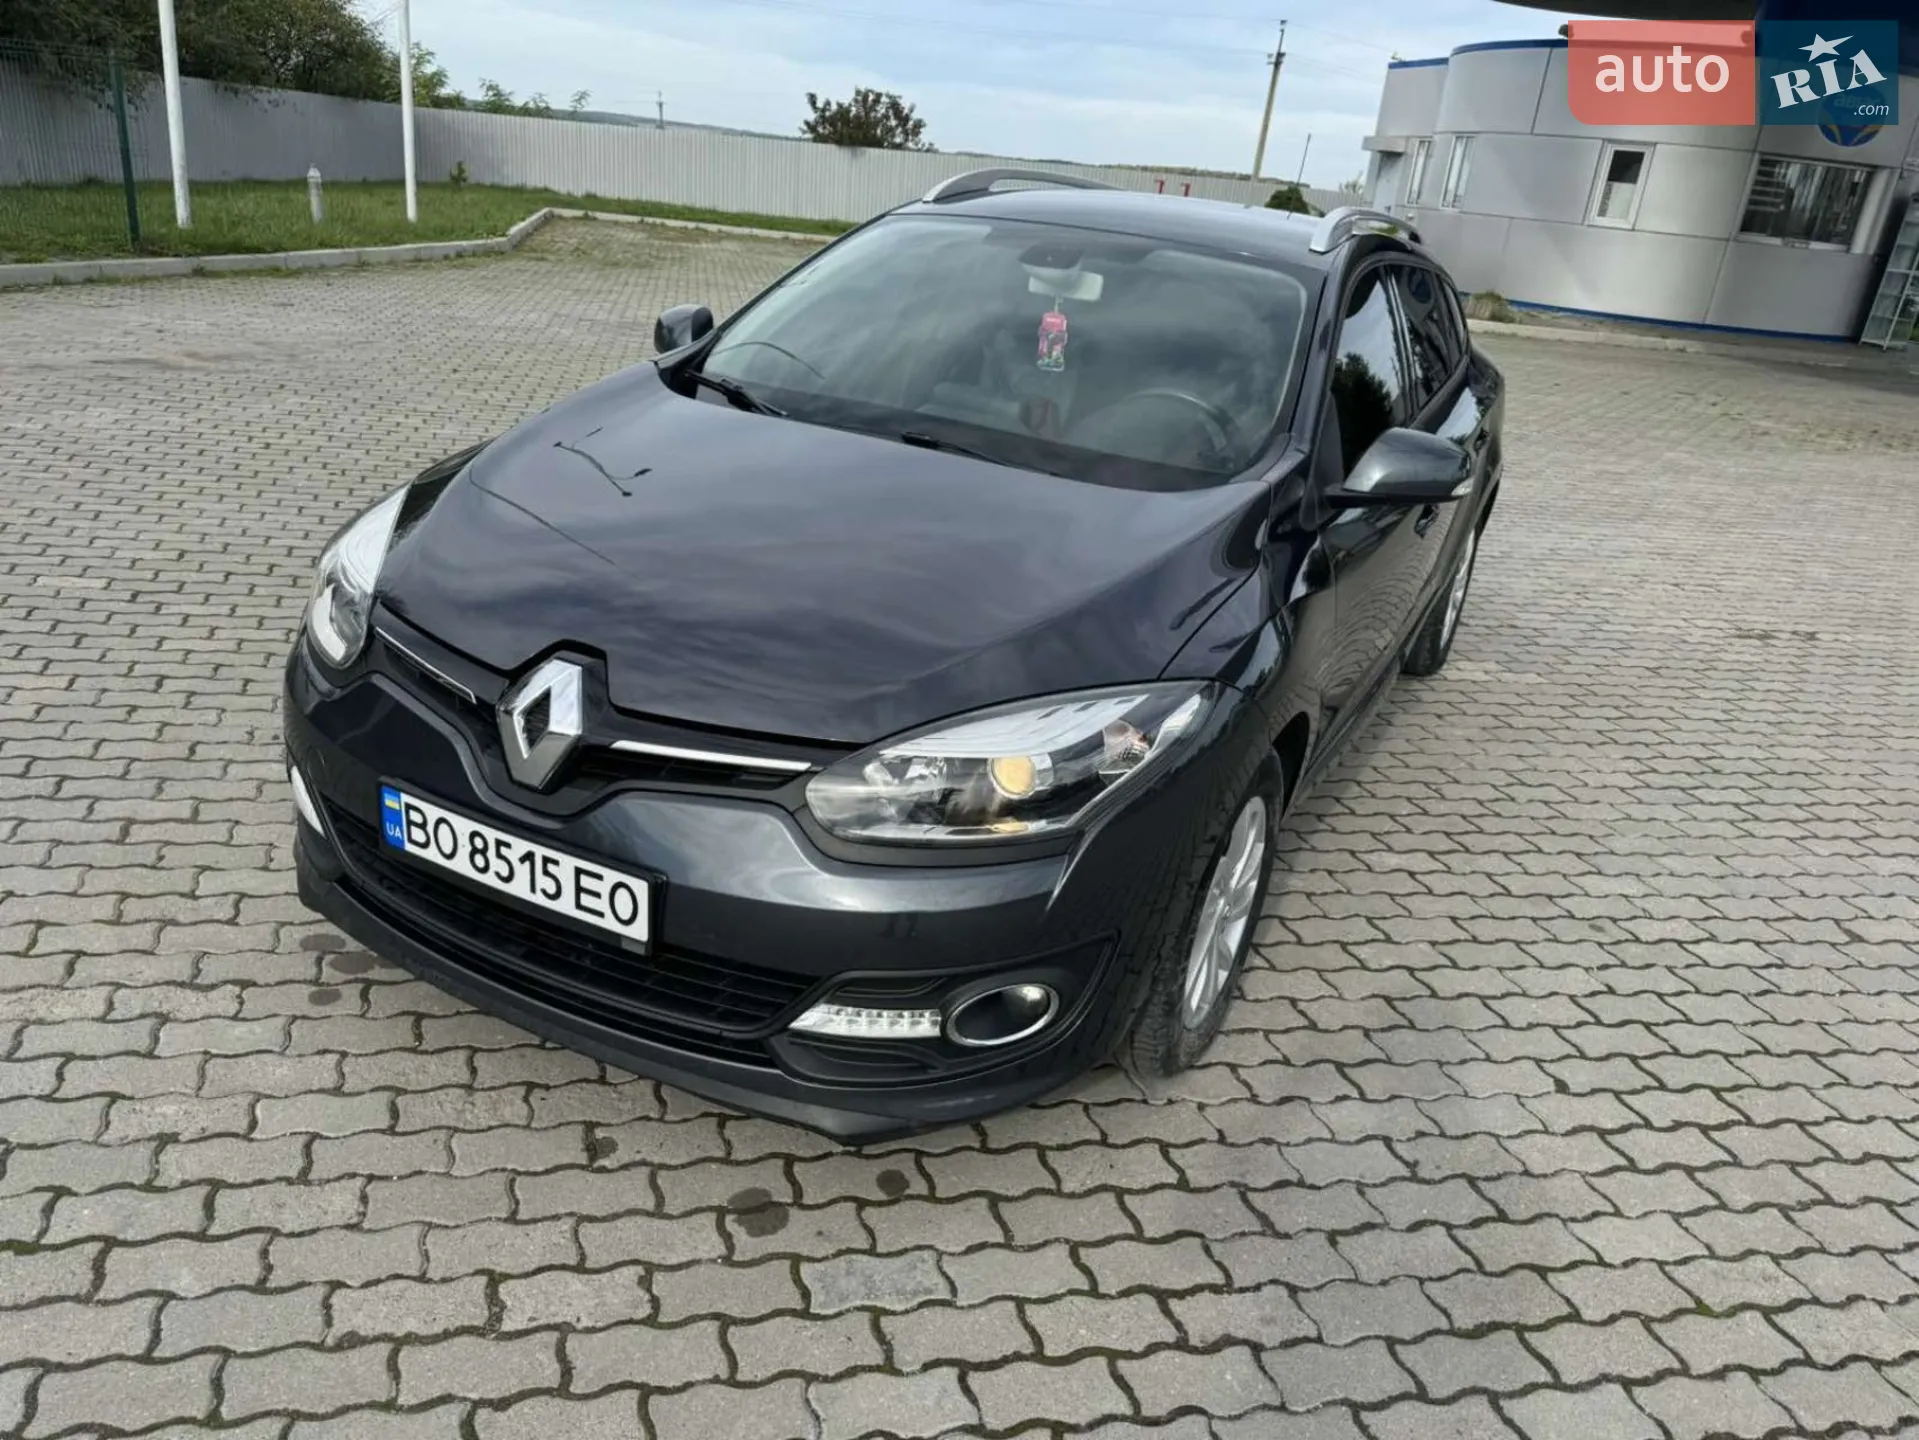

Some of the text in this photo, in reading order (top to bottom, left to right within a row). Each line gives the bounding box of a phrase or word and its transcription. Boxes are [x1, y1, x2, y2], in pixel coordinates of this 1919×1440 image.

[386, 821, 402, 840] UA
[404, 801, 638, 926] BO 8515 EO
